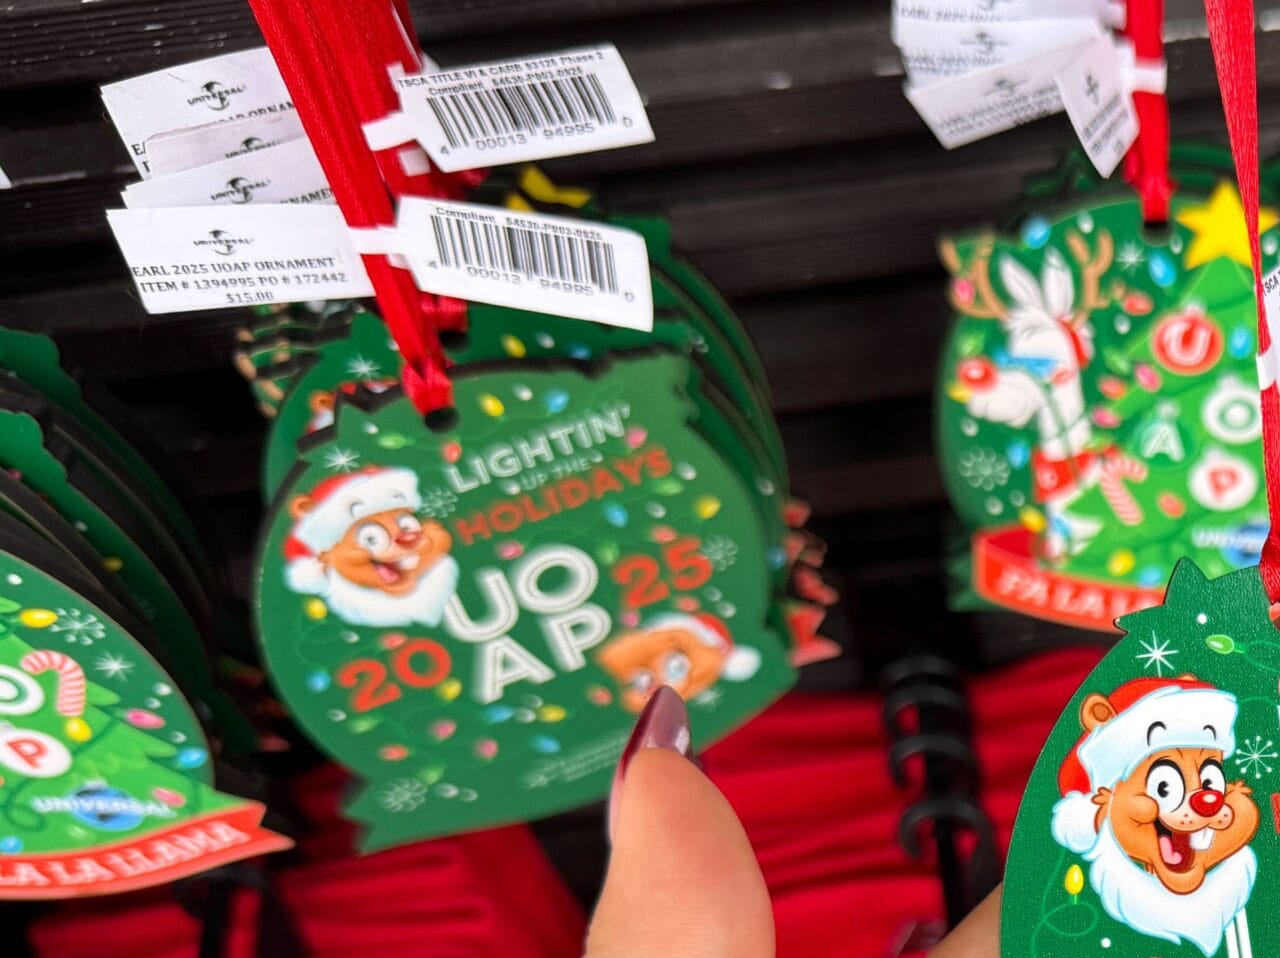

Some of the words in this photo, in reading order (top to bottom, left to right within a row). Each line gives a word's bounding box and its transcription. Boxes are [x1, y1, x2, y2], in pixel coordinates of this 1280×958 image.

[399, 76, 429, 88] TSCA
[430, 71, 463, 85] TITLE
[464, 69, 478, 80] VI
[596, 51, 604, 63] 2
[428, 81, 485, 97] Compliant
[439, 146, 450, 156] 4
[475, 132, 528, 152] 00013
[543, 122, 595, 141] 94995
[622, 115, 633, 128] 0
[435, 207, 496, 224] Compliant
[132, 265, 171, 277] EARL
[172, 263, 208, 275] 2025
[211, 261, 250, 274] UOAP
[254, 257, 336, 272] ORNAMENT
[141, 280, 178, 293] ITEM
[181, 280, 189, 290] #
[192, 276, 254, 291] 1394995
[258, 275, 278, 287] PO
[282, 274, 291, 285] #
[295, 272, 347, 286] 172442
[428, 259, 438, 270] 4
[467, 267, 522, 285] 00013
[539, 278, 594, 296] 94995
[624, 291, 635, 303] 0
[226, 290, 275, 304] $15.00
[446, 402, 631, 493] LIGHTIN'
[551, 457, 591, 480] THE
[456, 446, 673, 545] HOLIDAYS
[612, 536, 714, 608] 25
[335, 637, 453, 713] 20
[6, 738, 49, 768] P
[49, 856, 116, 886] LA
[106, 820, 252, 876] LLAMA
